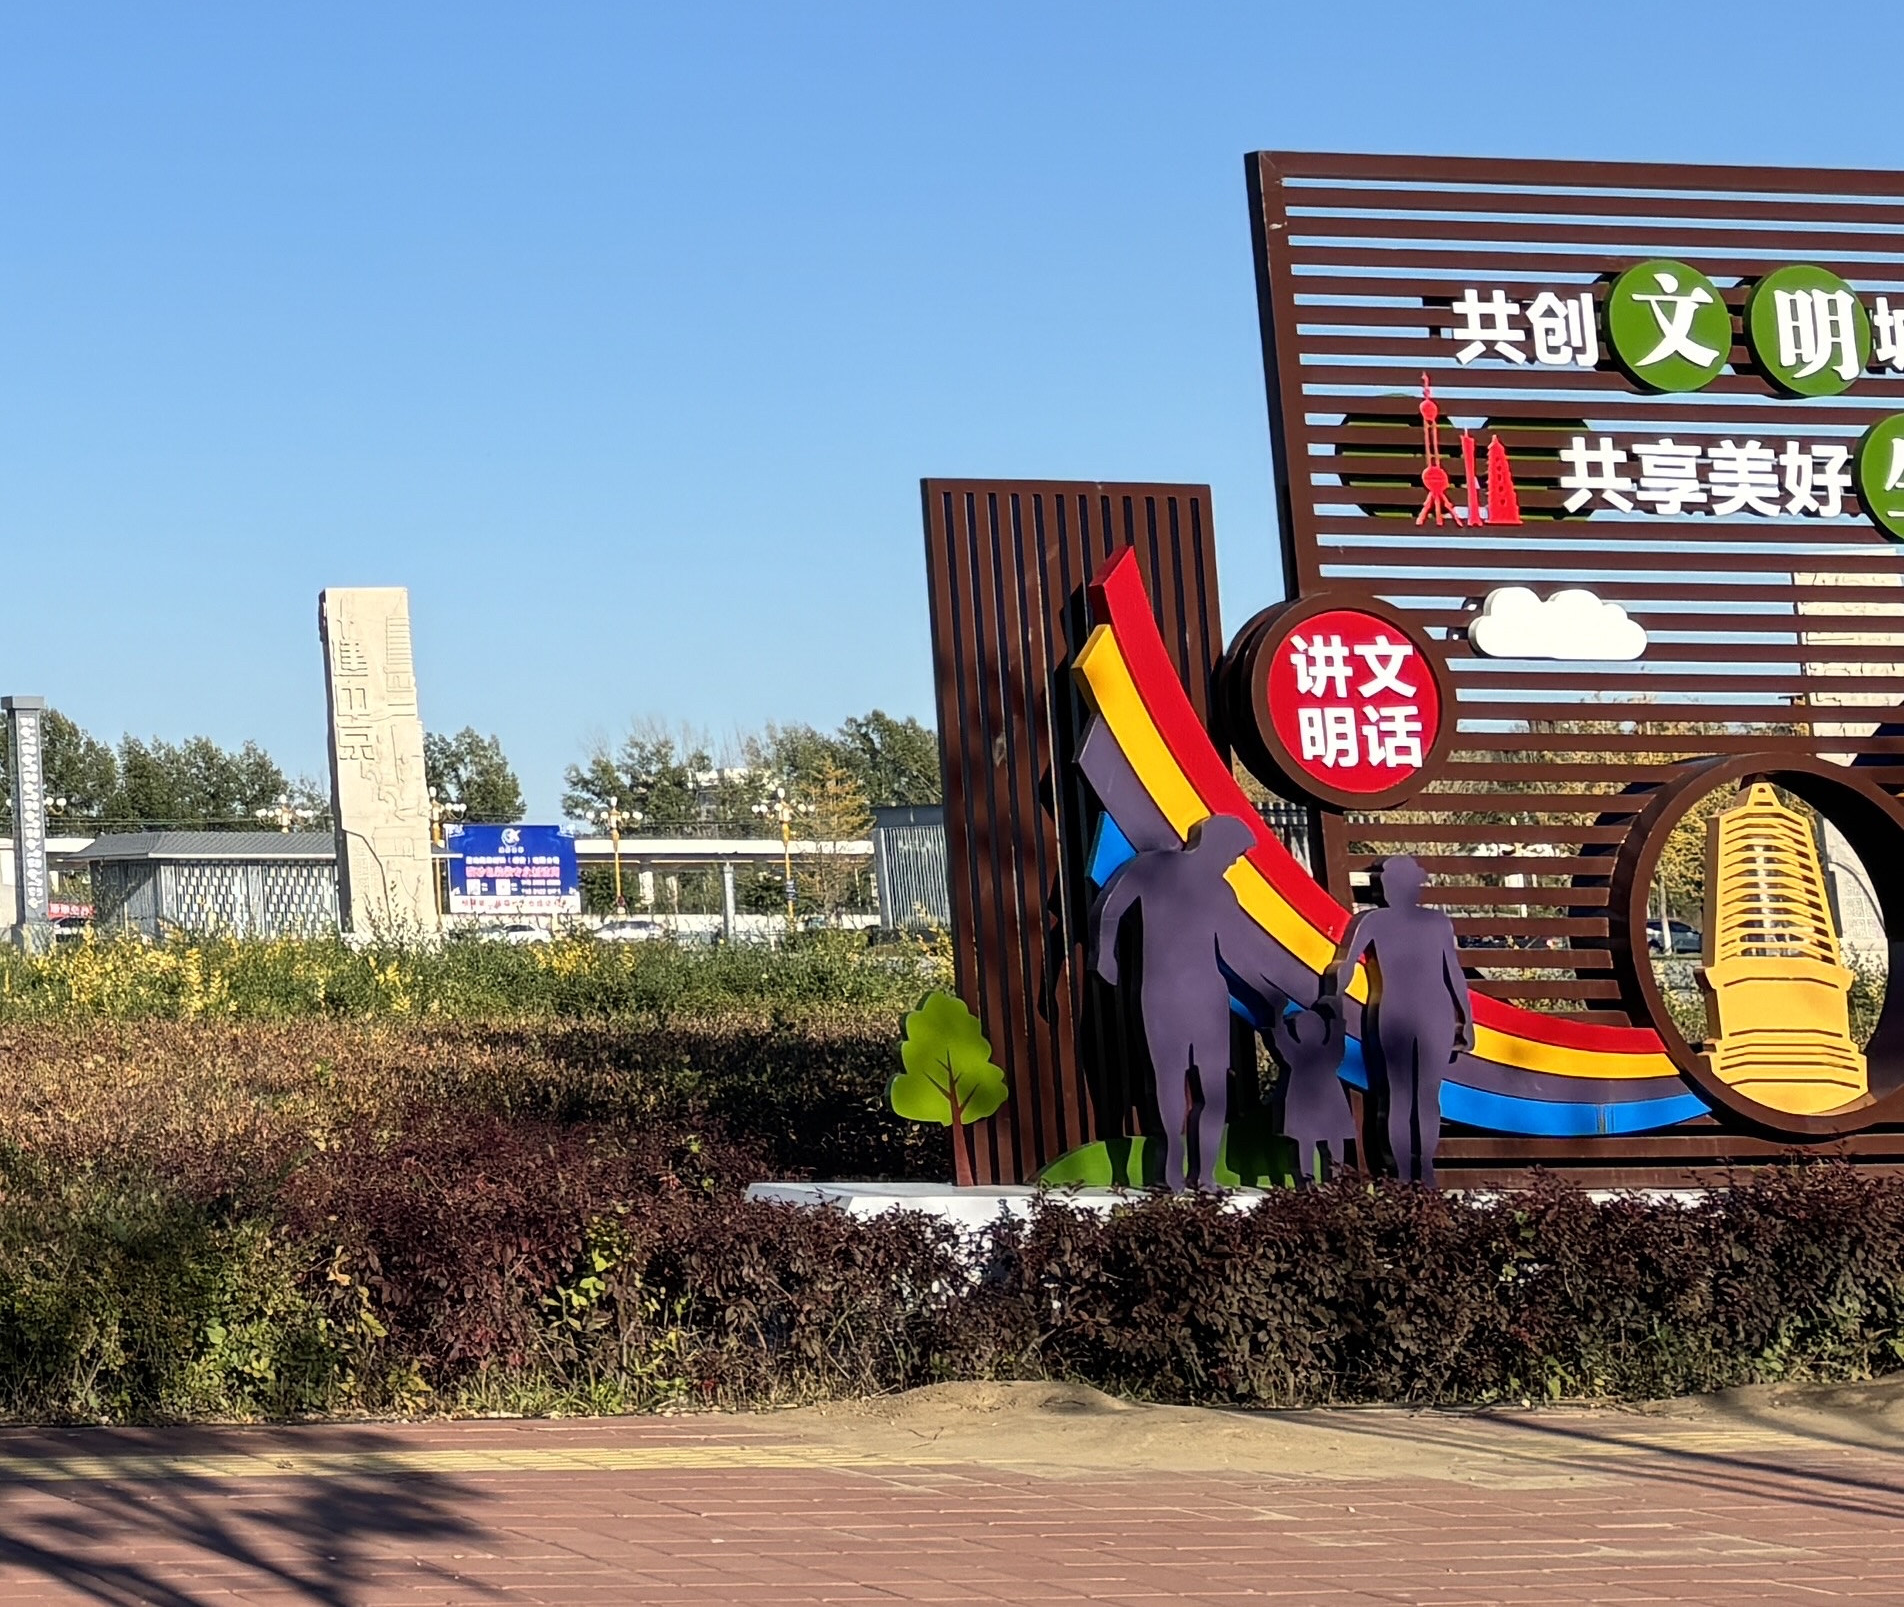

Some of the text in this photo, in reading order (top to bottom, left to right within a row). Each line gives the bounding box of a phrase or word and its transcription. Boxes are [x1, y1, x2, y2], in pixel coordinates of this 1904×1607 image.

[1558, 436, 1904, 519] 共享美好
[1289, 634, 1418, 699] 讲文
[1298, 704, 1423, 768] 明话
